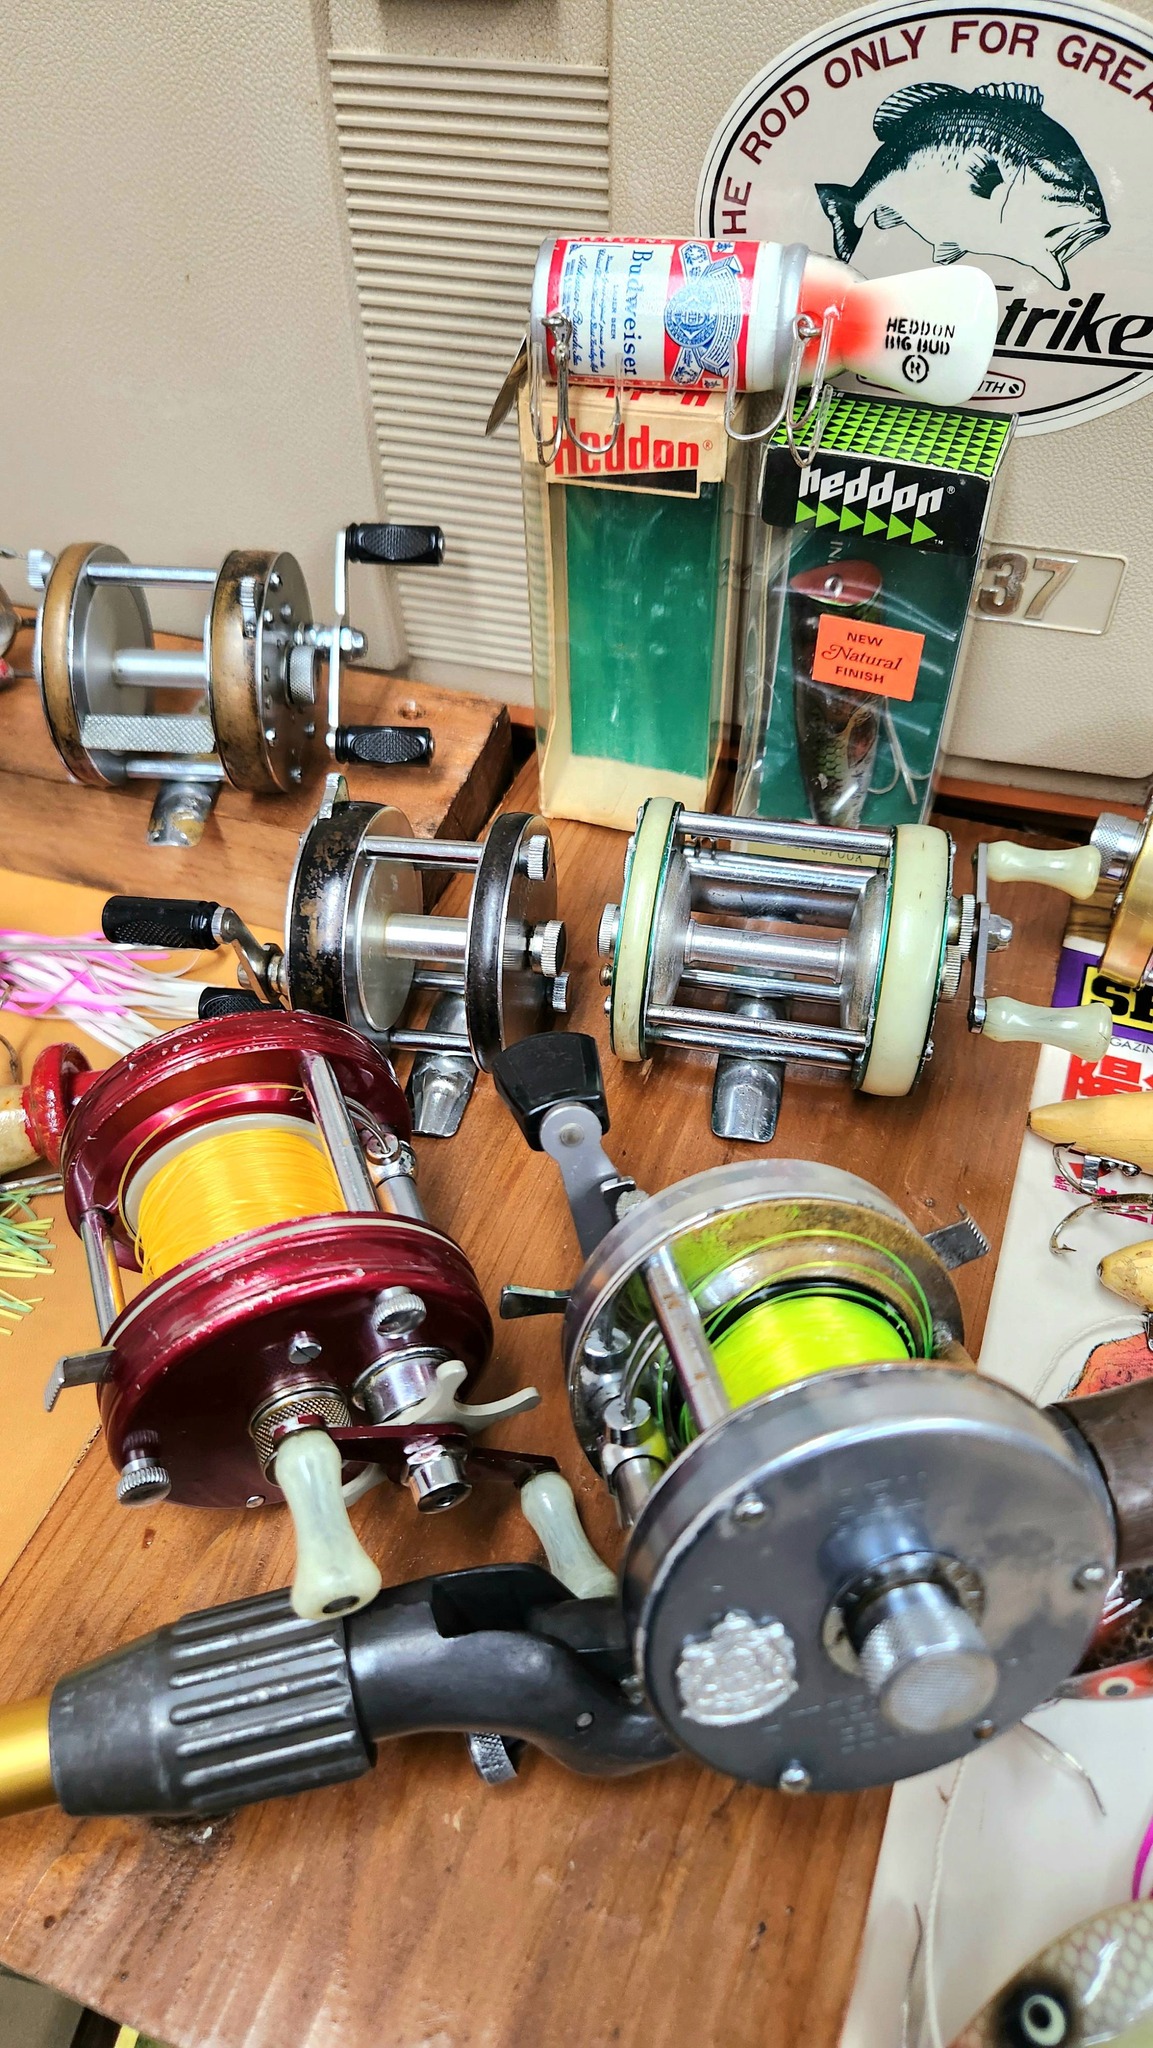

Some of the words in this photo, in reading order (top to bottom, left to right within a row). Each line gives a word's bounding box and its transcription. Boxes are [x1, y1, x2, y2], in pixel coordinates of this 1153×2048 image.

[721, 176, 752, 235] HE
[739, 84, 810, 165] ROD
[824, 25, 926, 89] ONLY
[951, 20, 1039, 58] FOR
[623, 249, 655, 376] Budweiser
[994, 285, 1153, 359] trike
[886, 316, 956, 339] HEDDON
[885, 334, 912, 352] BIG
[917, 337, 951, 356] BUD
[977, 552, 1078, 621] 37
[846, 632, 884, 647] NEW
[821, 643, 903, 671] Natural
[835, 665, 885, 684] FINISH
